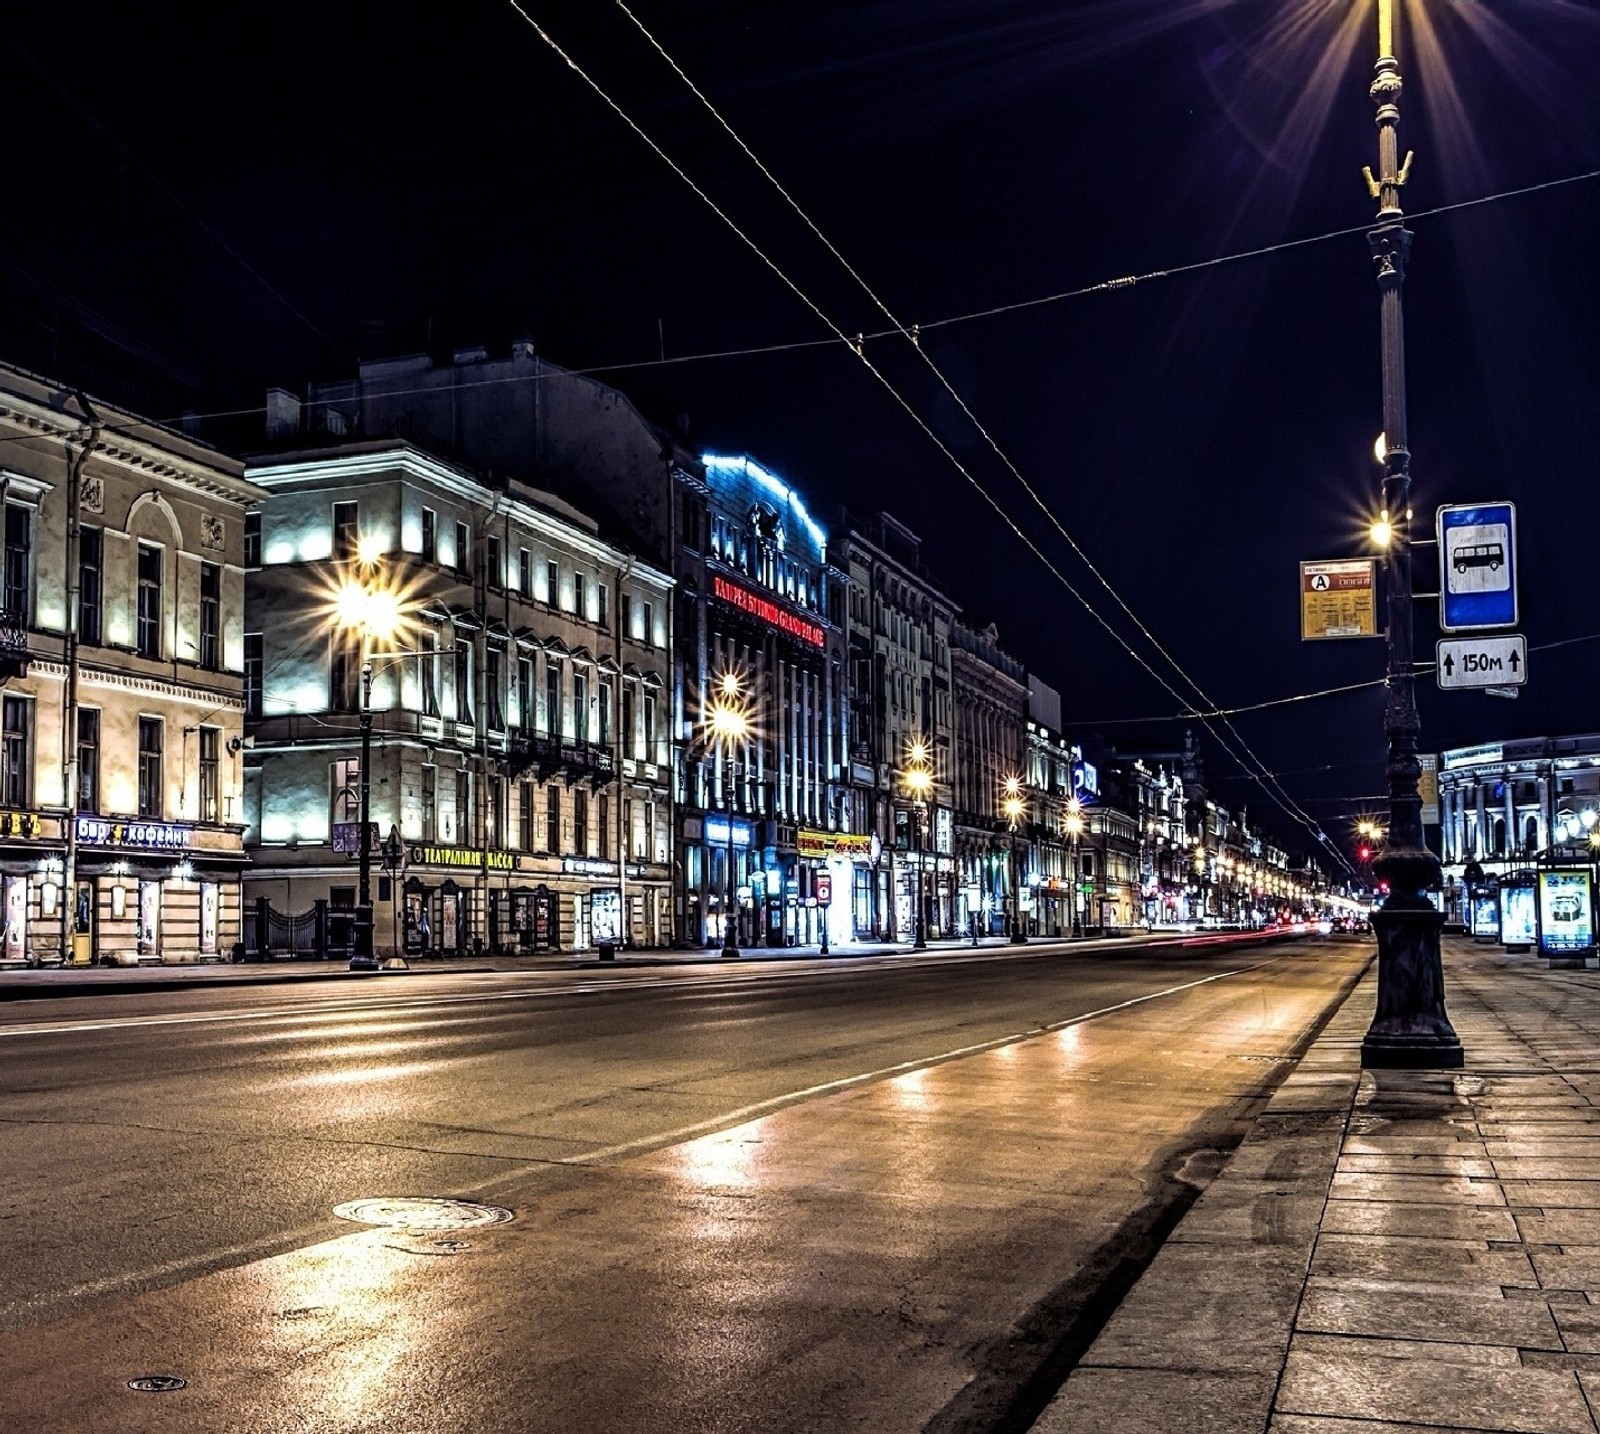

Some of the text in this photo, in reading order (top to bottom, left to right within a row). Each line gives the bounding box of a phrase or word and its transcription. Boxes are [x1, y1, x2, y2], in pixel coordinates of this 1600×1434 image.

[1315, 575, 1327, 589] А
[1462, 653, 1503, 673] 150м
[0, 813, 42, 835] ВЪ
[424, 847, 482, 866] ТЕАТРАЛЬНАЯ
